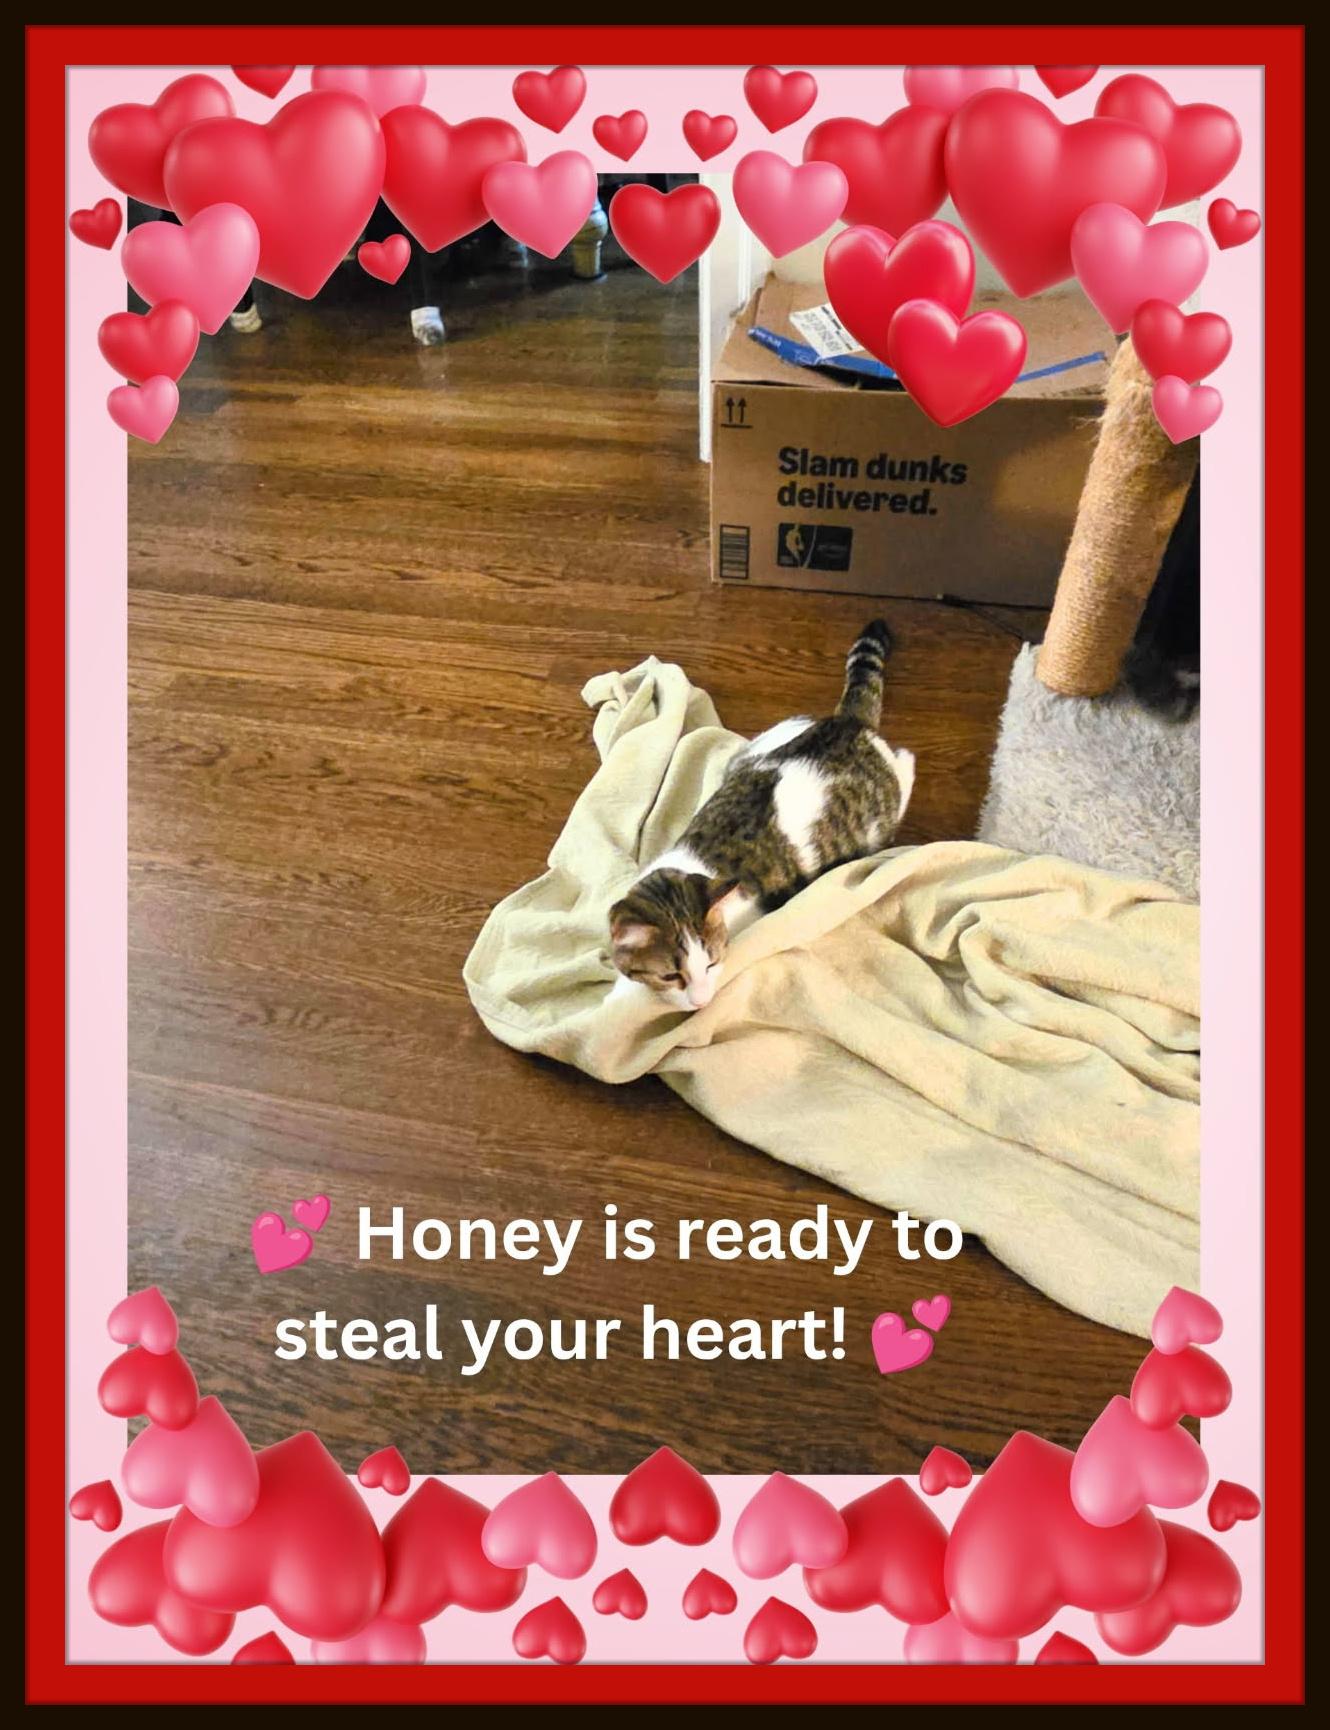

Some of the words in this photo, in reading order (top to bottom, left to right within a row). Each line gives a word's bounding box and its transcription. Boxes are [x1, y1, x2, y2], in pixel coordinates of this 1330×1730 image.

[778, 446, 859, 479] Slam
[866, 453, 968, 486] dunks
[777, 481, 938, 516] delivered.
